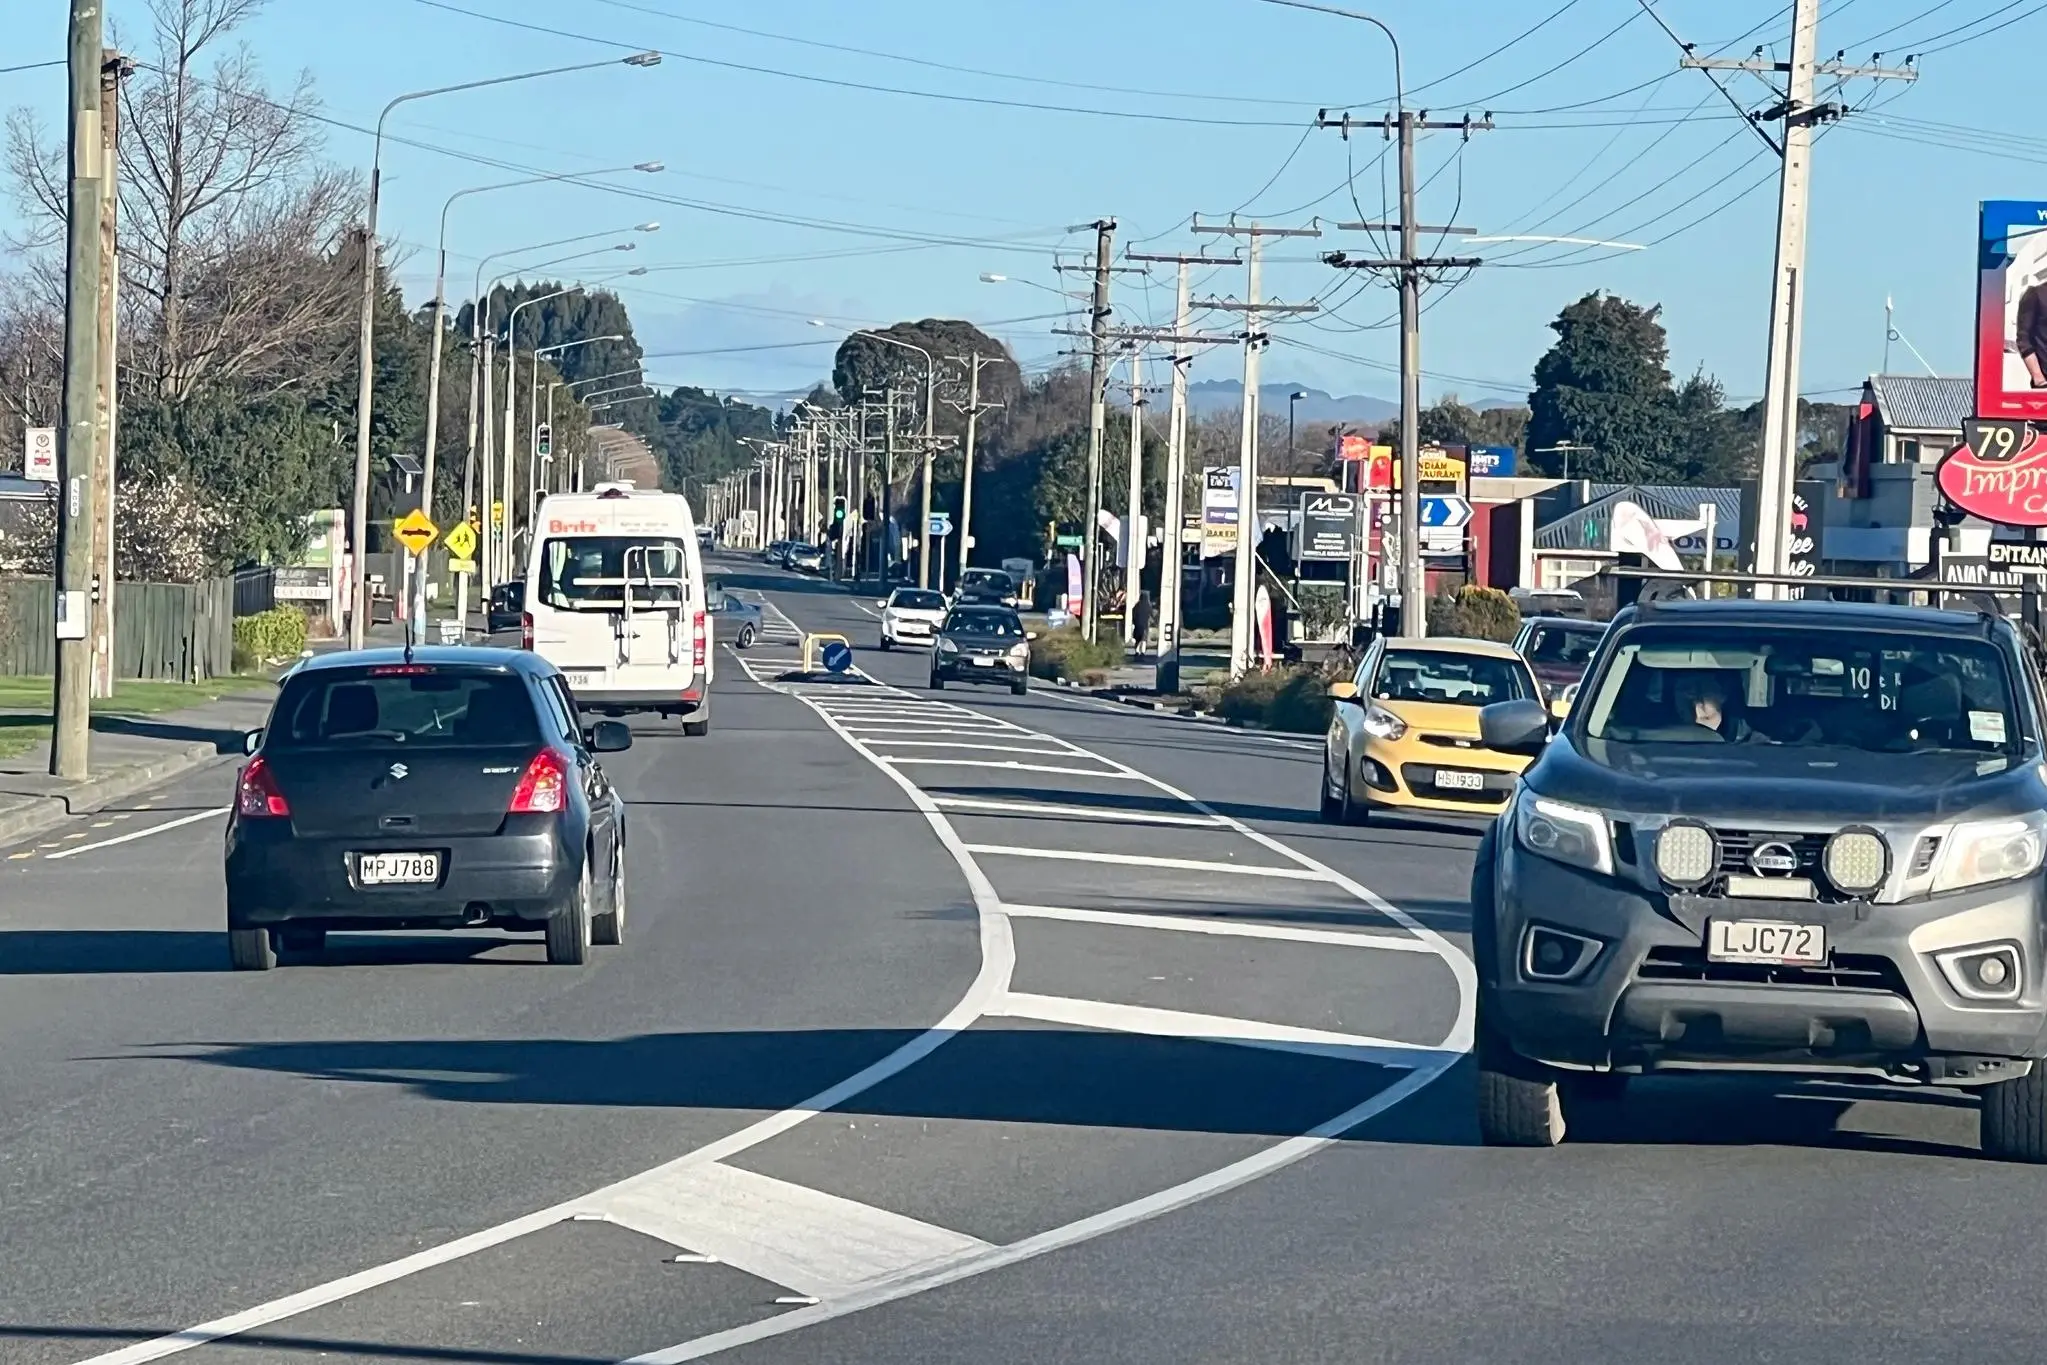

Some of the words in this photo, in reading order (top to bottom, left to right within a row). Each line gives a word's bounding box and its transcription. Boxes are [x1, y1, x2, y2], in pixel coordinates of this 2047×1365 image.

[1976, 426, 2015, 458] 79
[1418, 461, 1447, 470] NDIAN
[1418, 470, 1461, 479] TAURANT
[1962, 466, 2047, 504] Impr
[2023, 494, 2047, 513] C
[549, 519, 597, 534] Britz
[1669, 536, 1739, 550] OND
[363, 859, 435, 877] MPJ788
[1723, 926, 1812, 956] LJC72
